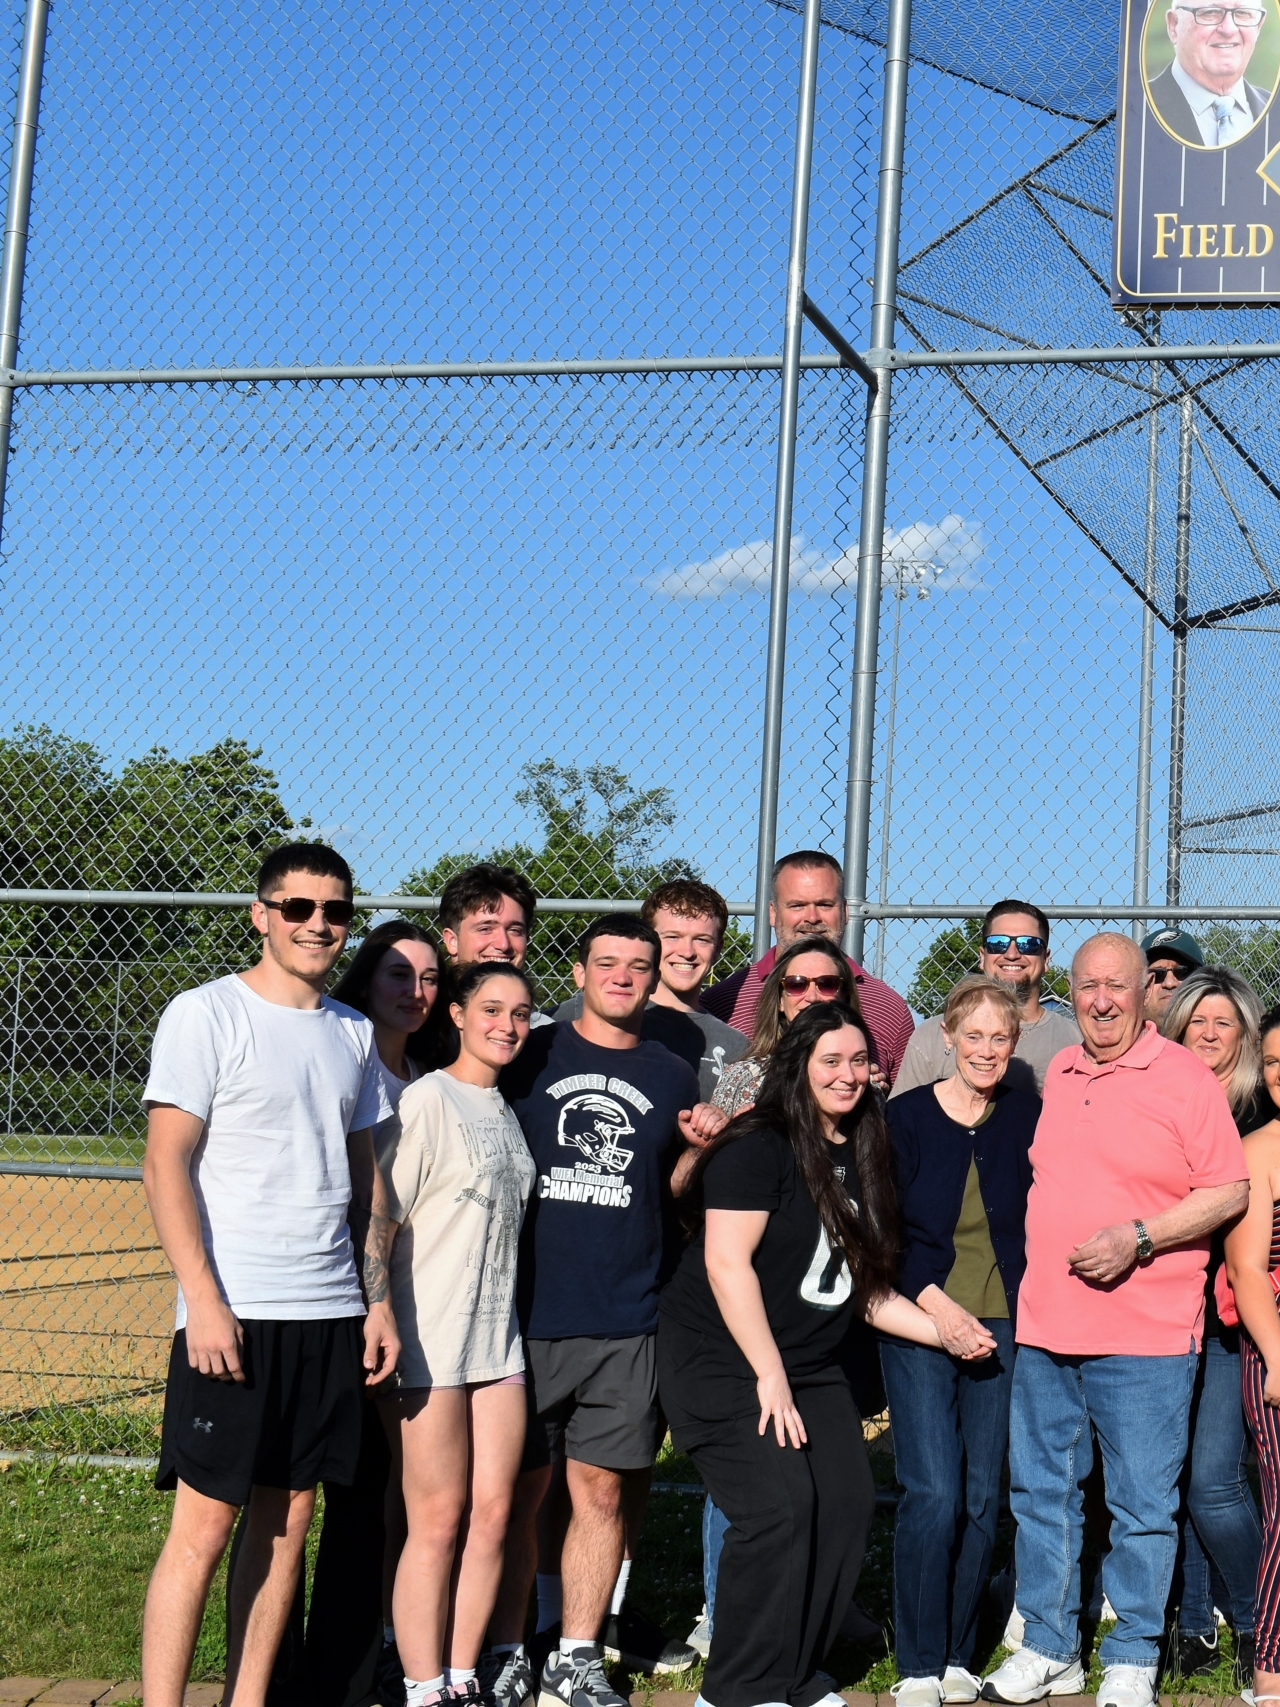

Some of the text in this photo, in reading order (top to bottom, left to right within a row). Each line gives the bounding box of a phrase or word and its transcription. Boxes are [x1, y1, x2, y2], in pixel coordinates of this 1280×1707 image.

[1152, 213, 1275, 259] FIELD
[546, 1073, 655, 1116] TIMBER CREEK
[574, 1161, 602, 1174] 2023
[575, 1169, 625, 1189] Memorial
[537, 1174, 633, 1208] CHAMPIONS
